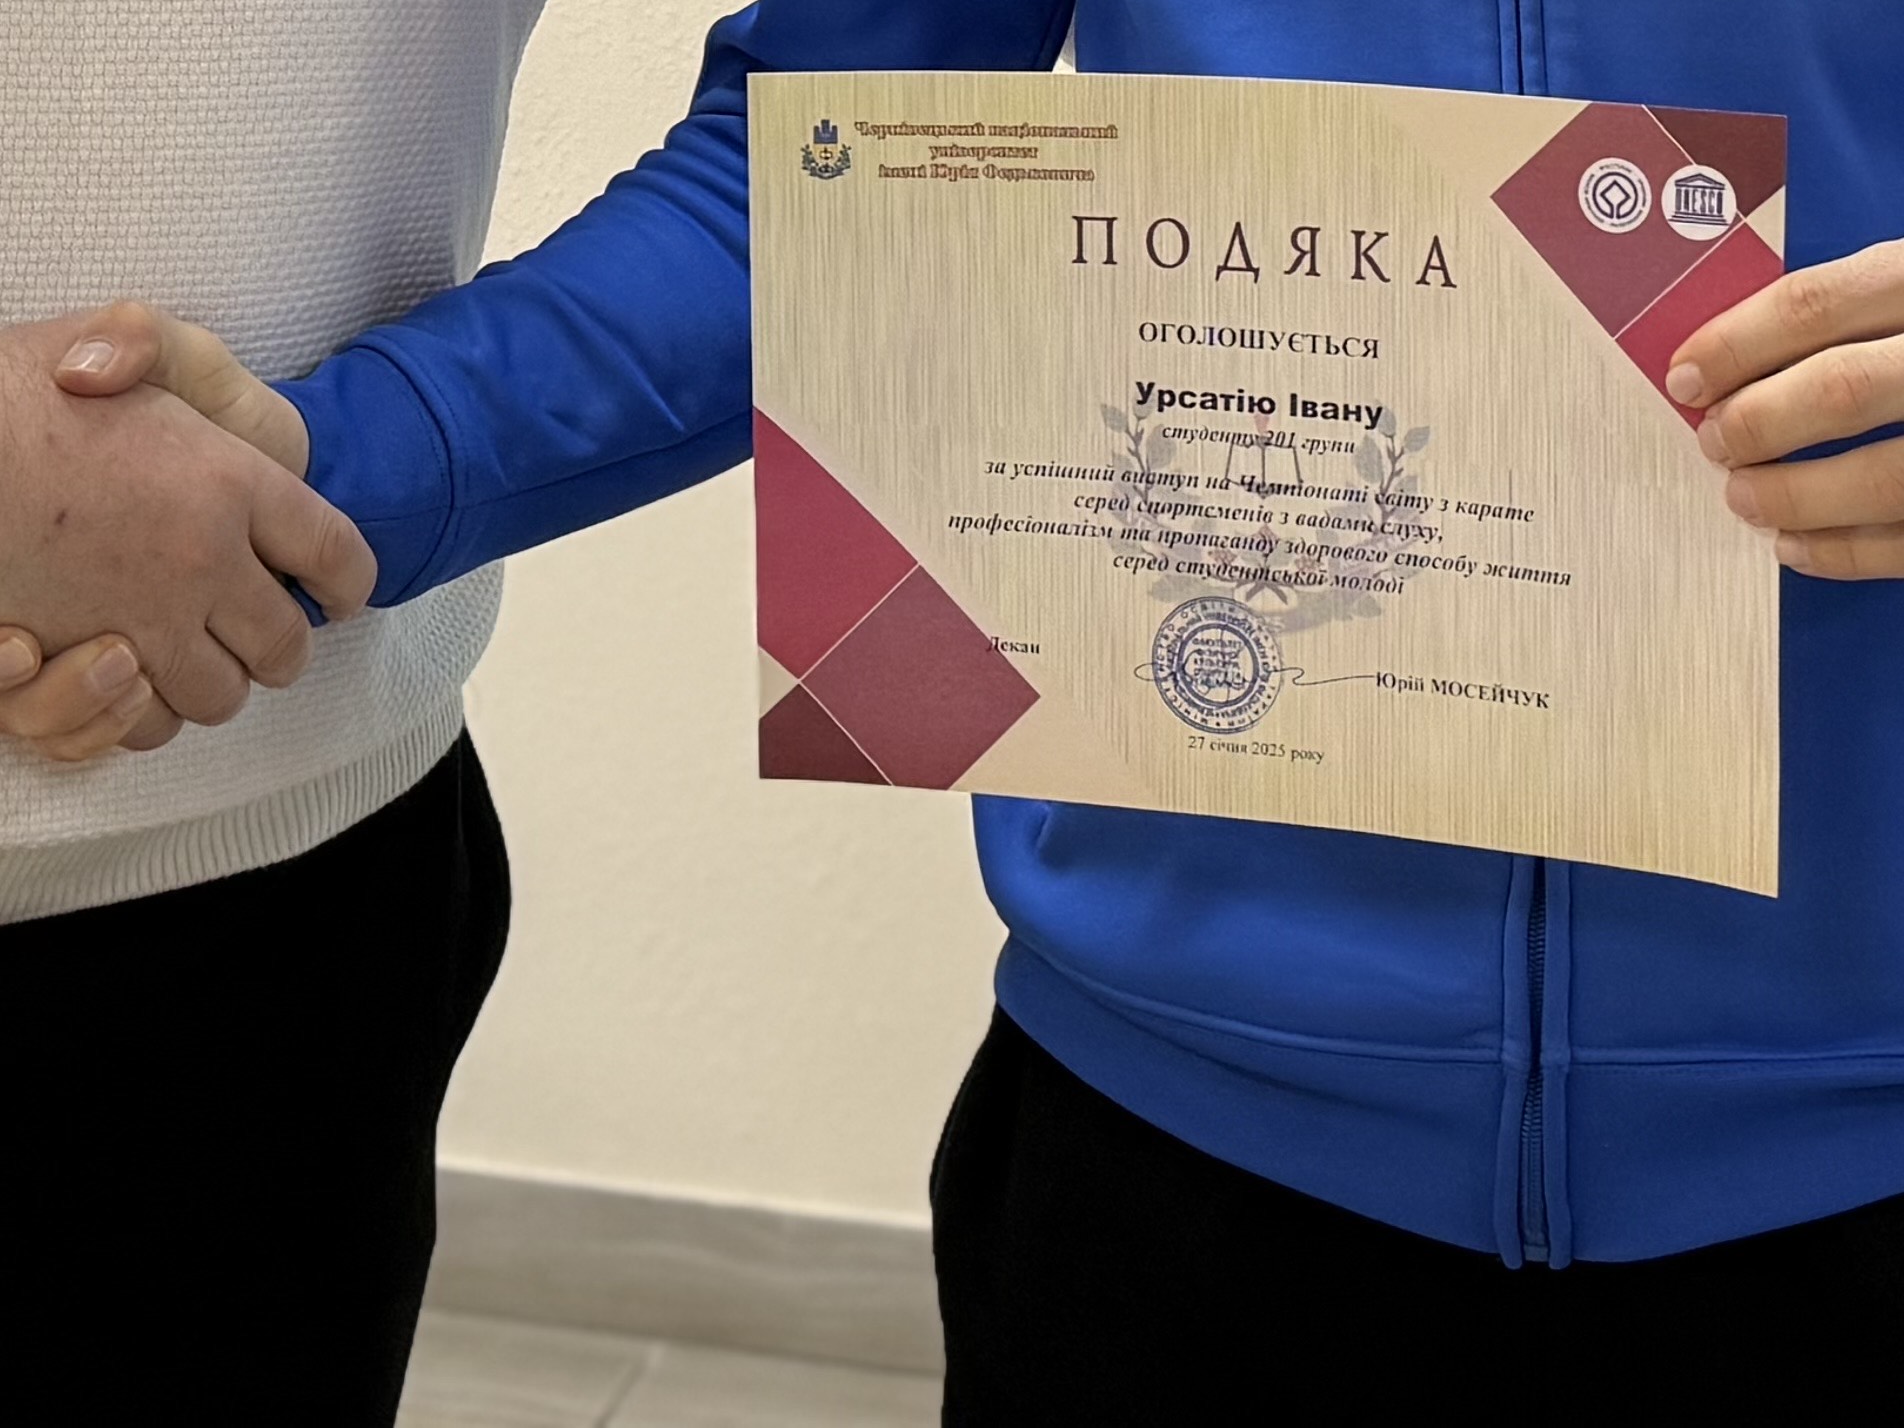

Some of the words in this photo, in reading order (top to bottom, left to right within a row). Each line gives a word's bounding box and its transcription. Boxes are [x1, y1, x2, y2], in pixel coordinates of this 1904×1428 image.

[1071, 215, 1458, 289] ПОДЯКА
[1138, 321, 1380, 359] ОГОЛОШУЄТЬСЯ
[1136, 380, 1277, 417] Урсатію
[1289, 392, 1384, 430] Івану
[1161, 424, 1259, 448] студенту
[1301, 435, 1356, 456] групи
[984, 459, 1007, 475] за
[1010, 460, 1115, 481] успішний
[1120, 468, 1199, 492] виступ
[1205, 475, 1231, 492] на
[1439, 499, 1449, 513] з
[1455, 500, 1536, 524] карате
[1073, 493, 1131, 514] серед
[1136, 498, 1274, 525] спортсменів
[1278, 511, 1289, 525] з
[1295, 509, 1375, 533] вадами
[1380, 522, 1444, 544] слуху,
[947, 512, 1114, 539] професіоналізм
[1119, 527, 1150, 543] та
[1157, 529, 1278, 556] пропаганду
[1283, 538, 1388, 564] здорового
[1393, 551, 1478, 578] способу
[1482, 562, 1572, 587] життя
[1112, 552, 1169, 575] серед
[1329, 574, 1405, 595] молоді
[988, 634, 1040, 656] Декан
[1375, 668, 1426, 695] Юрій
[1430, 675, 1550, 710] МОСЕЙЧУК
[1187, 735, 1206, 751] 27
[1251, 740, 1286, 759] 2025
[1289, 746, 1325, 765] року
